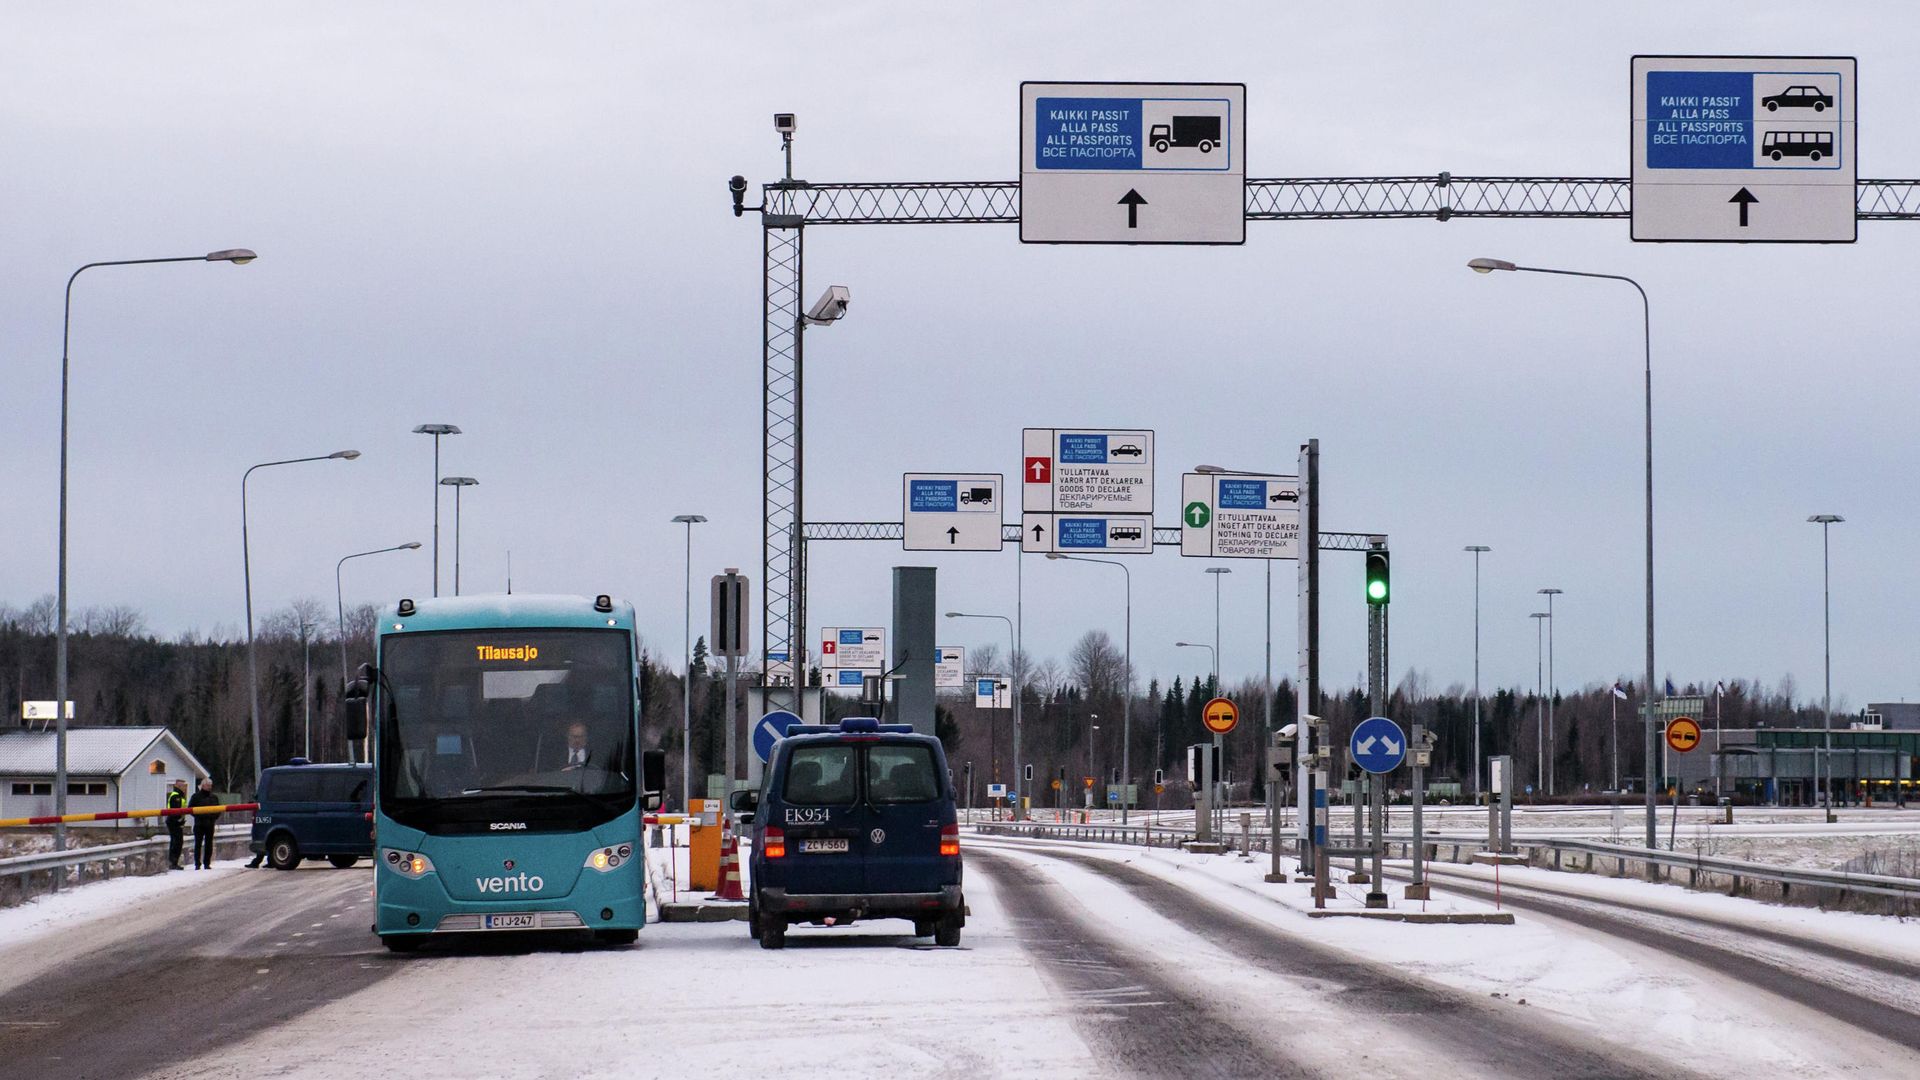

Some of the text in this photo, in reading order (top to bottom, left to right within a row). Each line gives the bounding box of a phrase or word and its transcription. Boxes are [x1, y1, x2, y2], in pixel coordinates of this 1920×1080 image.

[1660, 96, 1741, 107] KAIKKI PASSIT
[1050, 110, 1130, 121] KAIKKI PASSIT
[1671, 109, 1730, 119] ALLA PASS
[1060, 123, 1119, 133] ALLA PASS
[1657, 122, 1744, 132] ALL PASSPORTS
[1046, 135, 1133, 146] ALL PASSPORTS
[1653, 134, 1747, 145] ВСЕ ПАСПОРТА
[1043, 147, 1136, 158] ВСЕ ПАСПОРТА
[1059, 494, 1133, 502] ДЕКЛАРИРУЕМЫЕ
[1227, 514, 1277, 522] TULLATTAVAA
[1218, 546, 1255, 554] ТОВАРОВ
[476, 645, 539, 662] Tilausajo
[785, 808, 831, 822] EK954
[807, 840, 846, 850] ZCY-560
[476, 872, 544, 893] vento
[493, 916, 532, 927] CIJ-247
